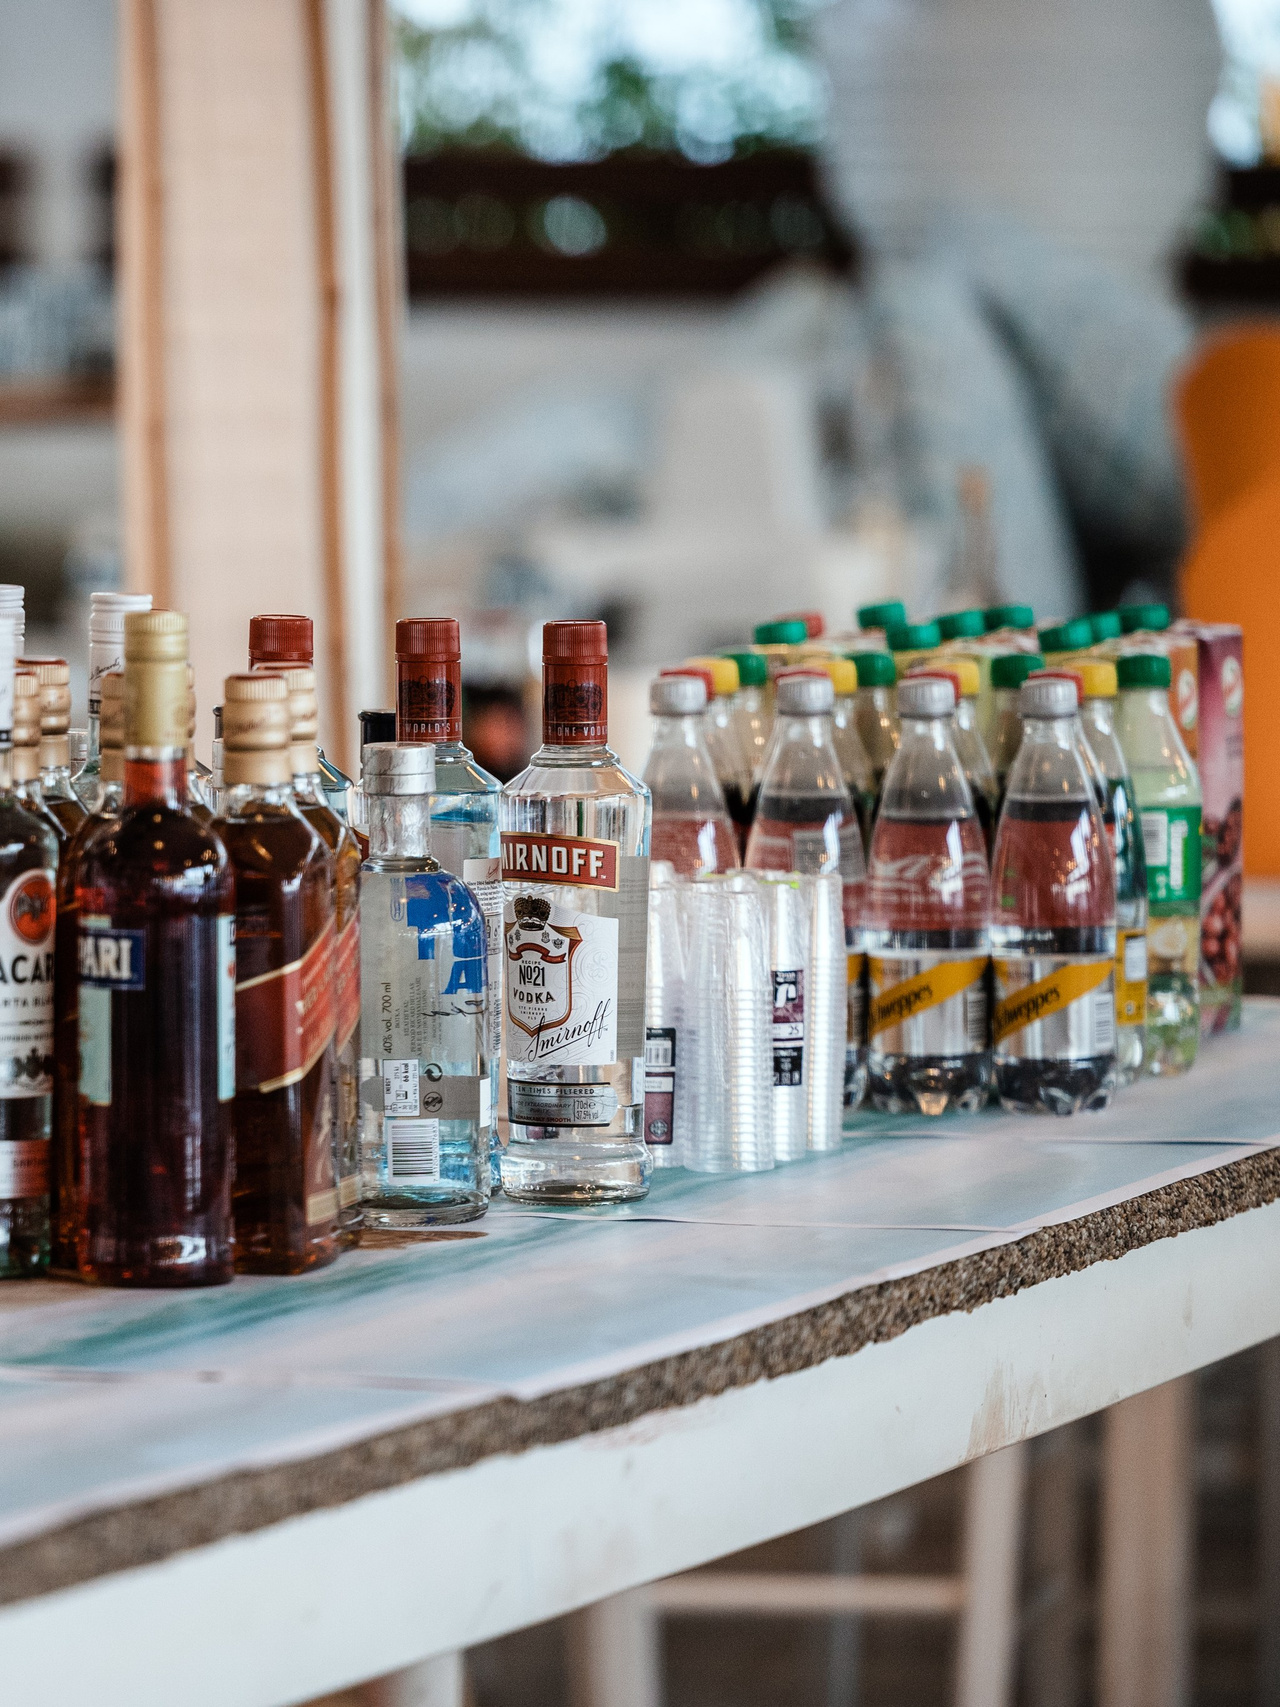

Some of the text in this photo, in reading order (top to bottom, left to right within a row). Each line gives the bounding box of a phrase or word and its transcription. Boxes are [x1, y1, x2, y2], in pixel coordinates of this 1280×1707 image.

[405, 722, 451, 733] WORLD'S
[380, 982, 391, 993] ml
[513, 987, 556, 1005] VODKA
[382, 994, 392, 1013] 700
[525, 998, 613, 1062] Smirnoff
[382, 1035, 393, 1054] 40%
[401, 1063, 410, 1074] kcal
[524, 1101, 571, 1109] EXTRAORDINARY
